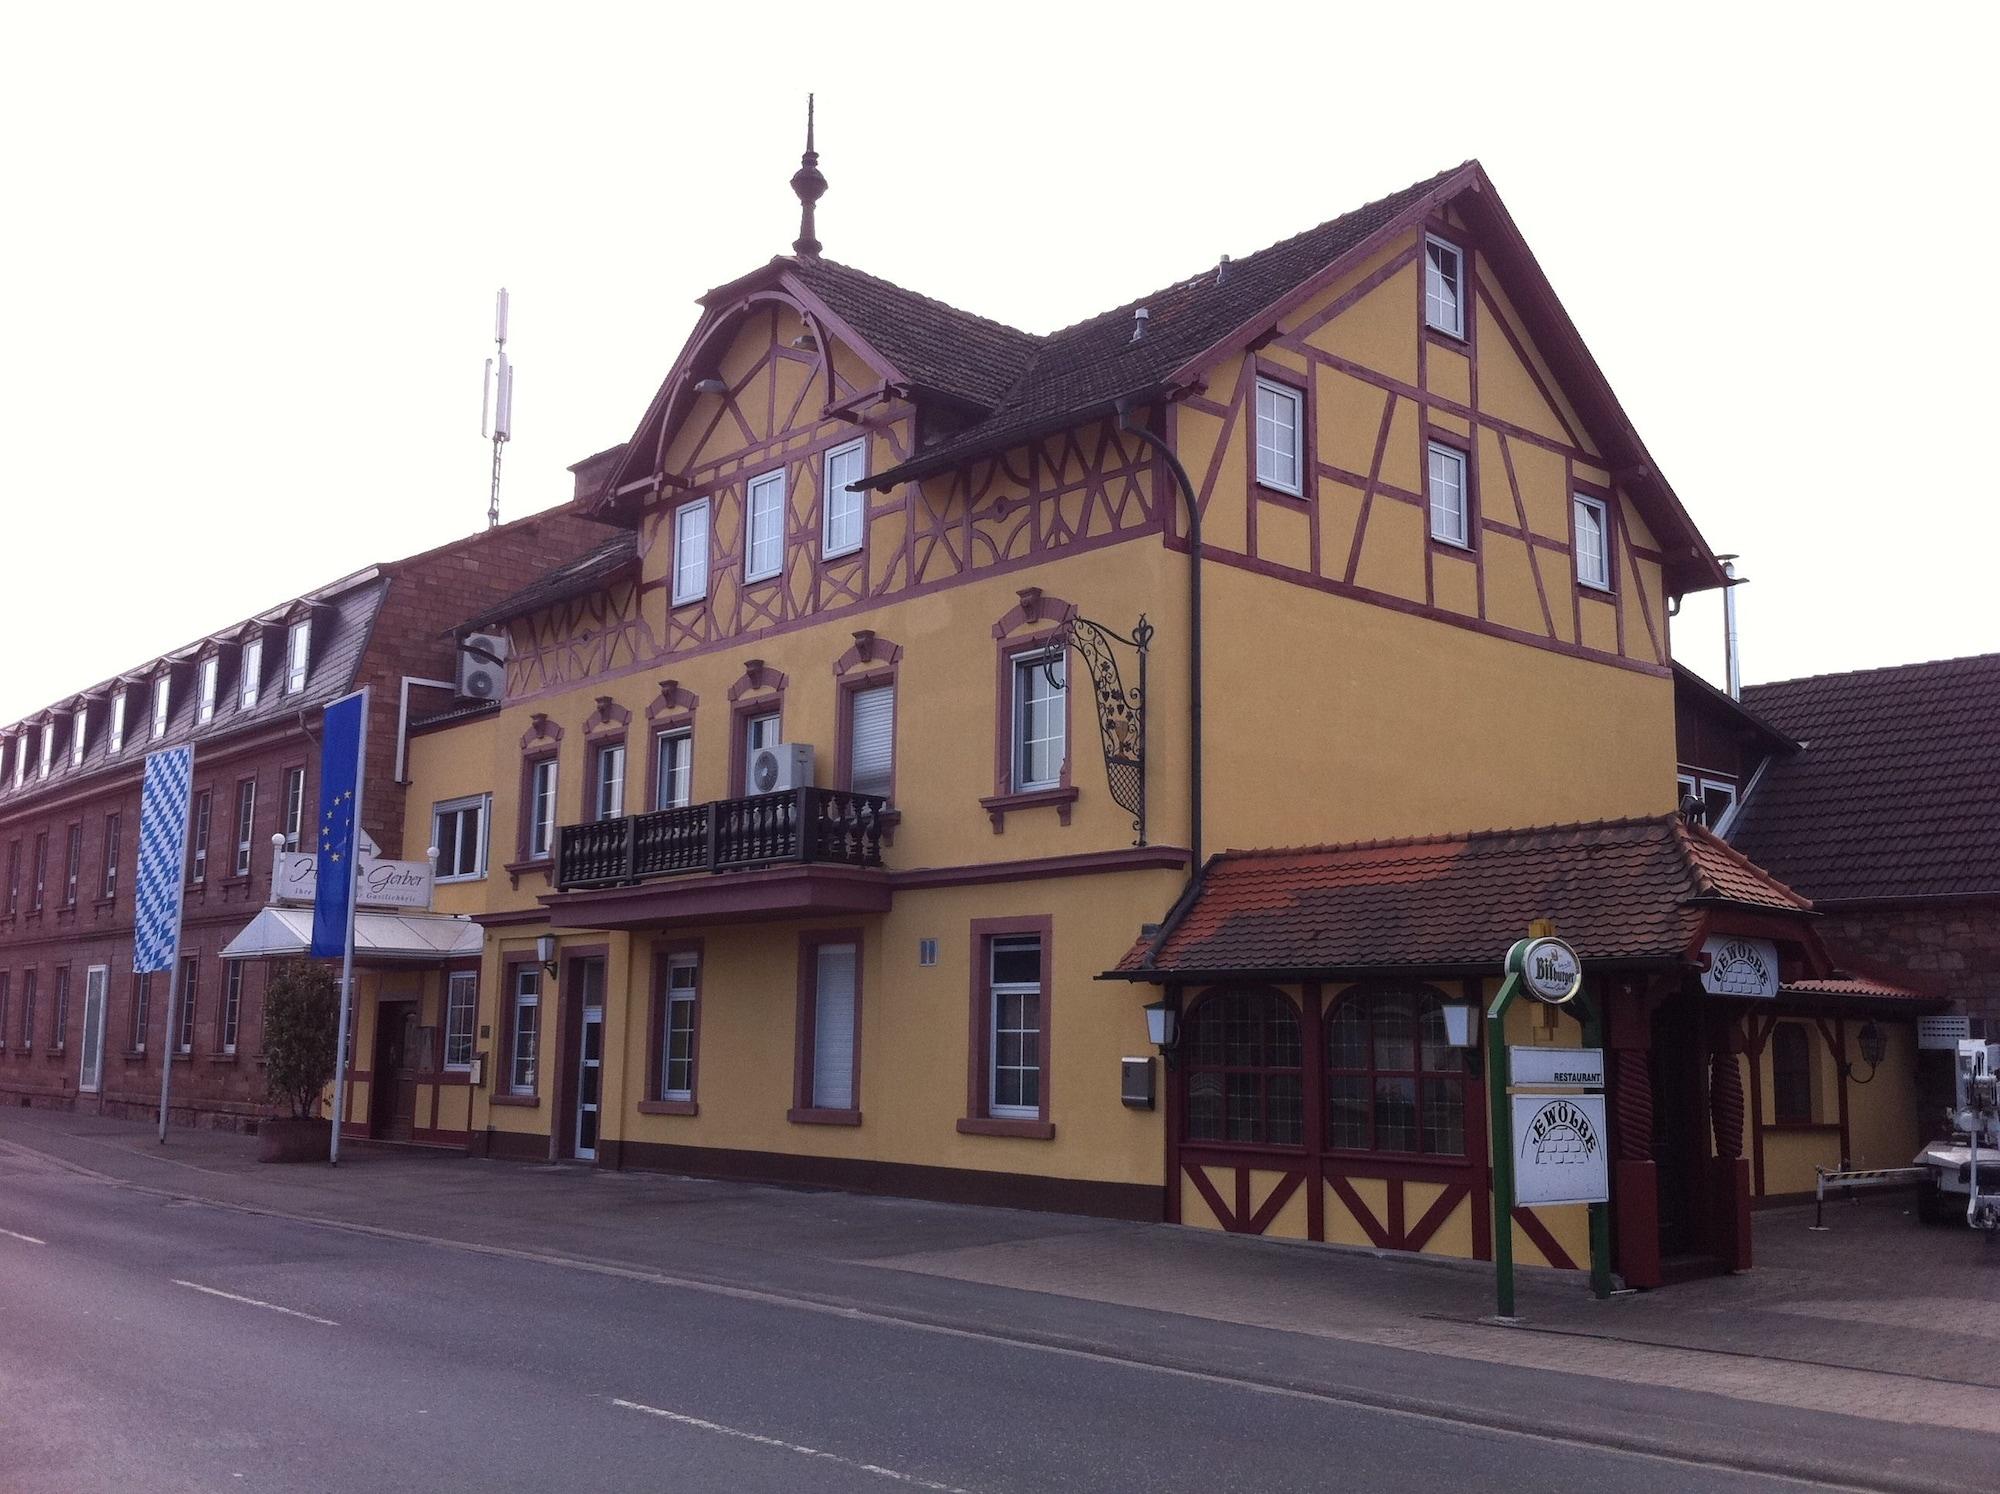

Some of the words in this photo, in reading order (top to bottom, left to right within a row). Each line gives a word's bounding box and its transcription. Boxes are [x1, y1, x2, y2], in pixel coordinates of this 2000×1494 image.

[367, 865, 425, 893] Gerber
[1535, 956, 1575, 986] Bitburger
[1553, 1072, 1601, 1082] RESTAURANT
